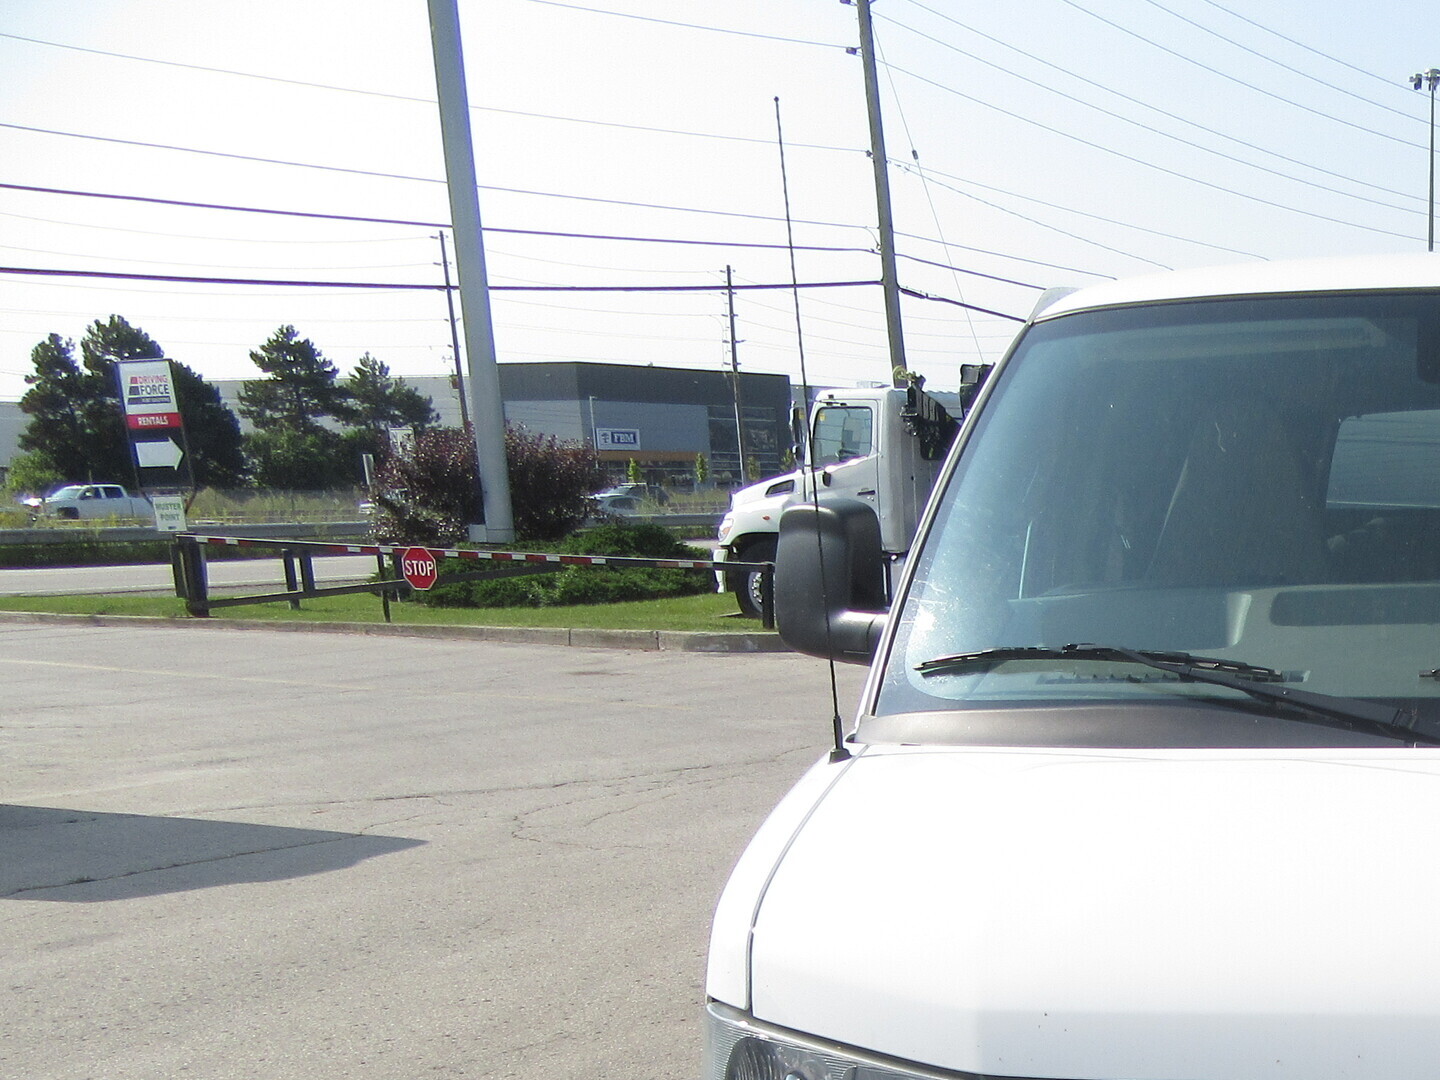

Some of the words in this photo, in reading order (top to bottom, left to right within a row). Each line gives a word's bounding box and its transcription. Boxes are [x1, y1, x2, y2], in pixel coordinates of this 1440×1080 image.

[140, 383, 170, 396] FORCE
[137, 415, 169, 426] RENTALS
[404, 560, 434, 576] STOP
